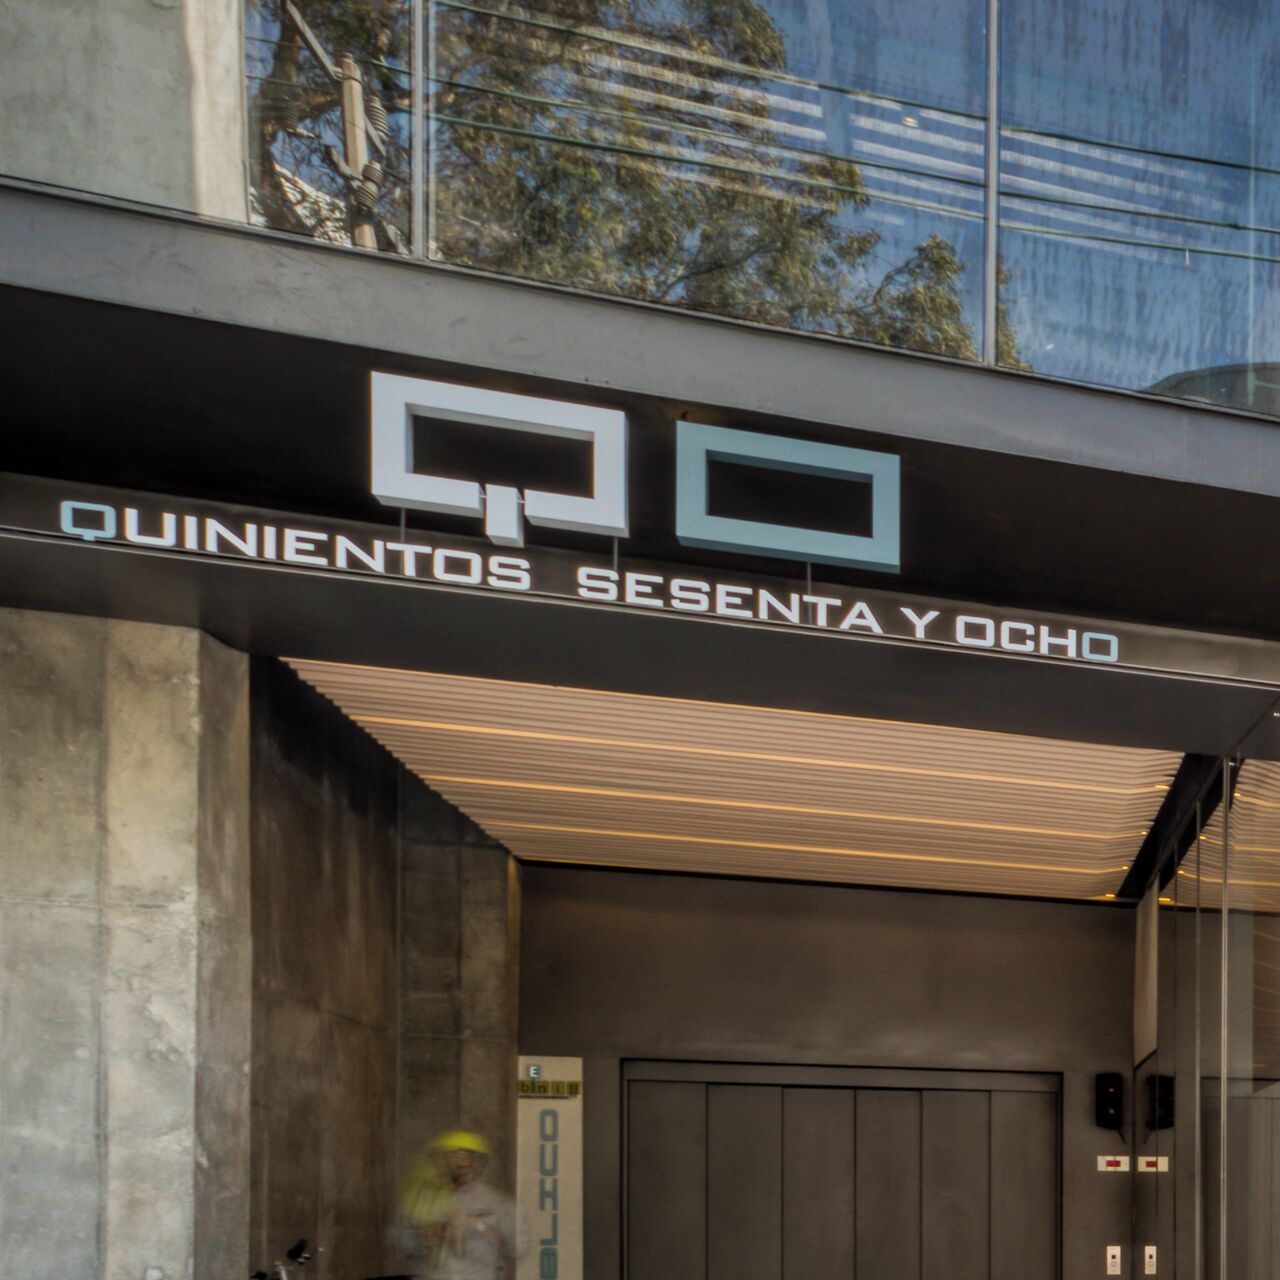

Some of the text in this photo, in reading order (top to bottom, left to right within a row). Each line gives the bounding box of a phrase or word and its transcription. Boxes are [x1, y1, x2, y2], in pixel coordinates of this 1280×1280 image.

[60, 500, 1121, 663] QUINIENTOS SESENTA Y OCHO
